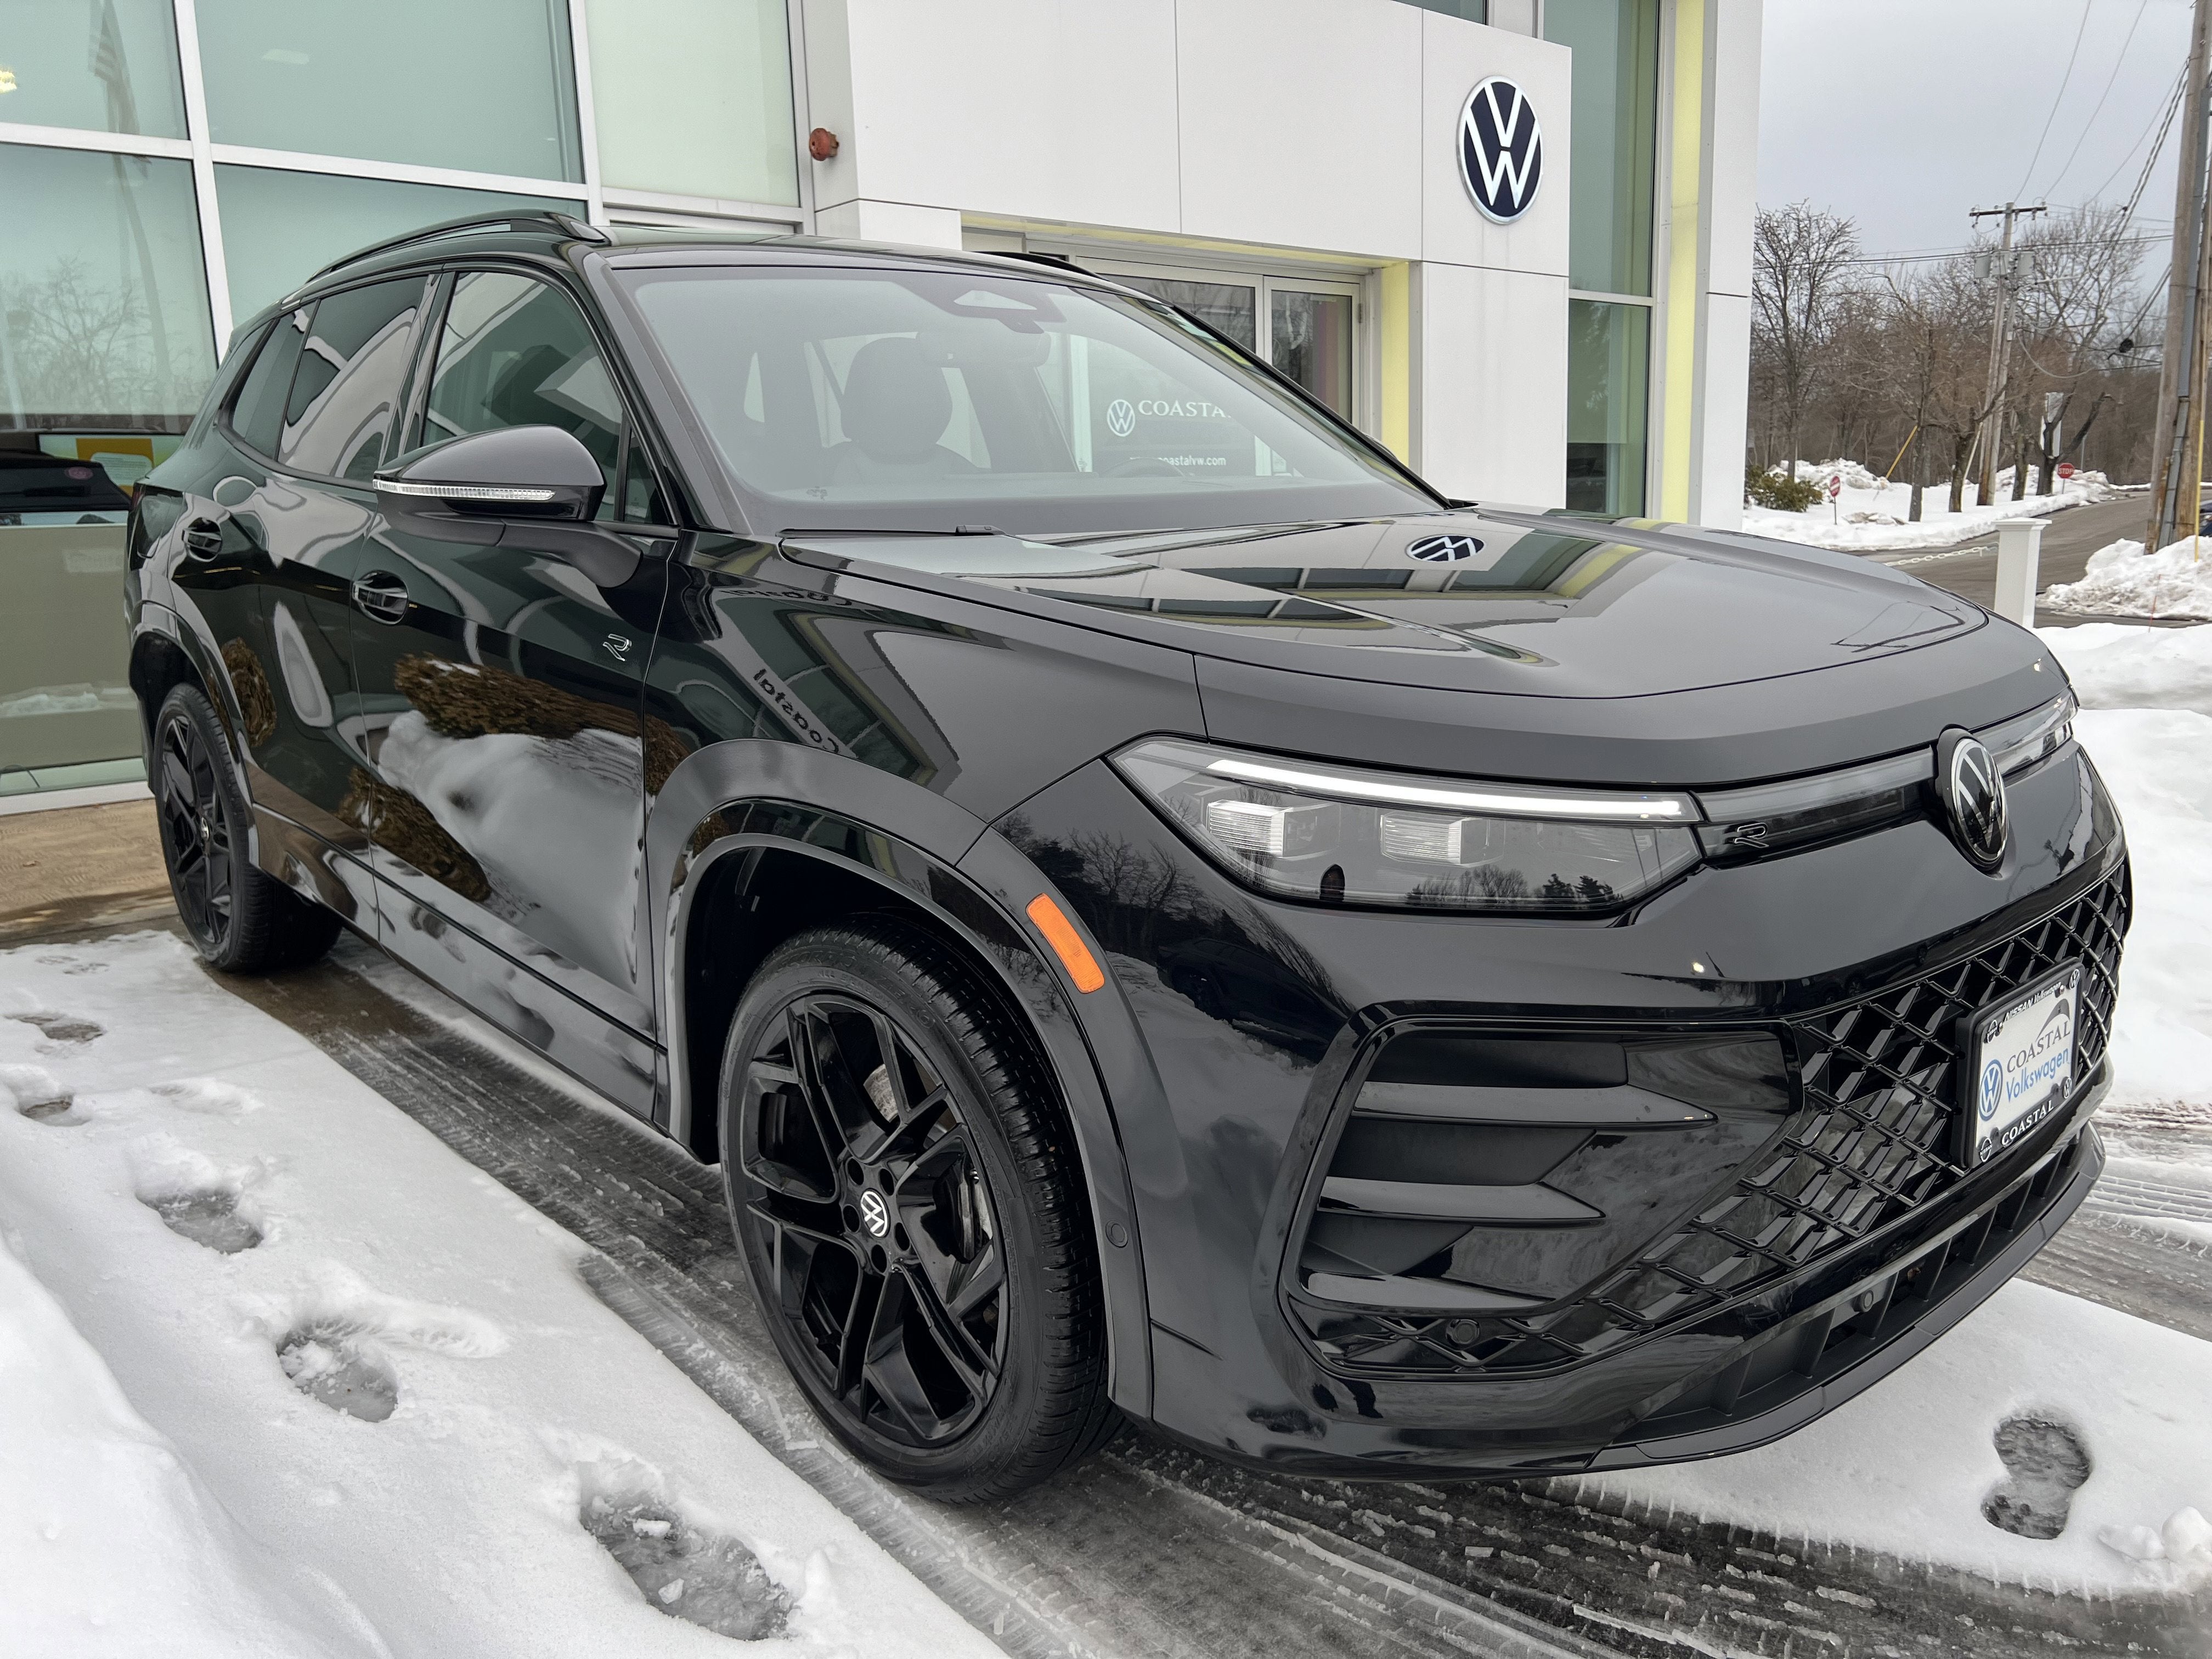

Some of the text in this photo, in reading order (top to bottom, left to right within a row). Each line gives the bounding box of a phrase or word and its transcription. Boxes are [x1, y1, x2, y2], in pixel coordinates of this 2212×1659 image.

[1460, 78, 1543, 217] VW
[1138, 400, 1232, 418] COASTA
[1733, 822, 1770, 849] R
[2004, 997, 2034, 1023] NISSAN
[2006, 1021, 2070, 1074] COASTAL
[1978, 1059, 2004, 1121] VW
[2006, 1048, 2069, 1103] Volkswagen
[2001, 1100, 2054, 1146] COASTAL
[860, 1190, 888, 1237] VW
